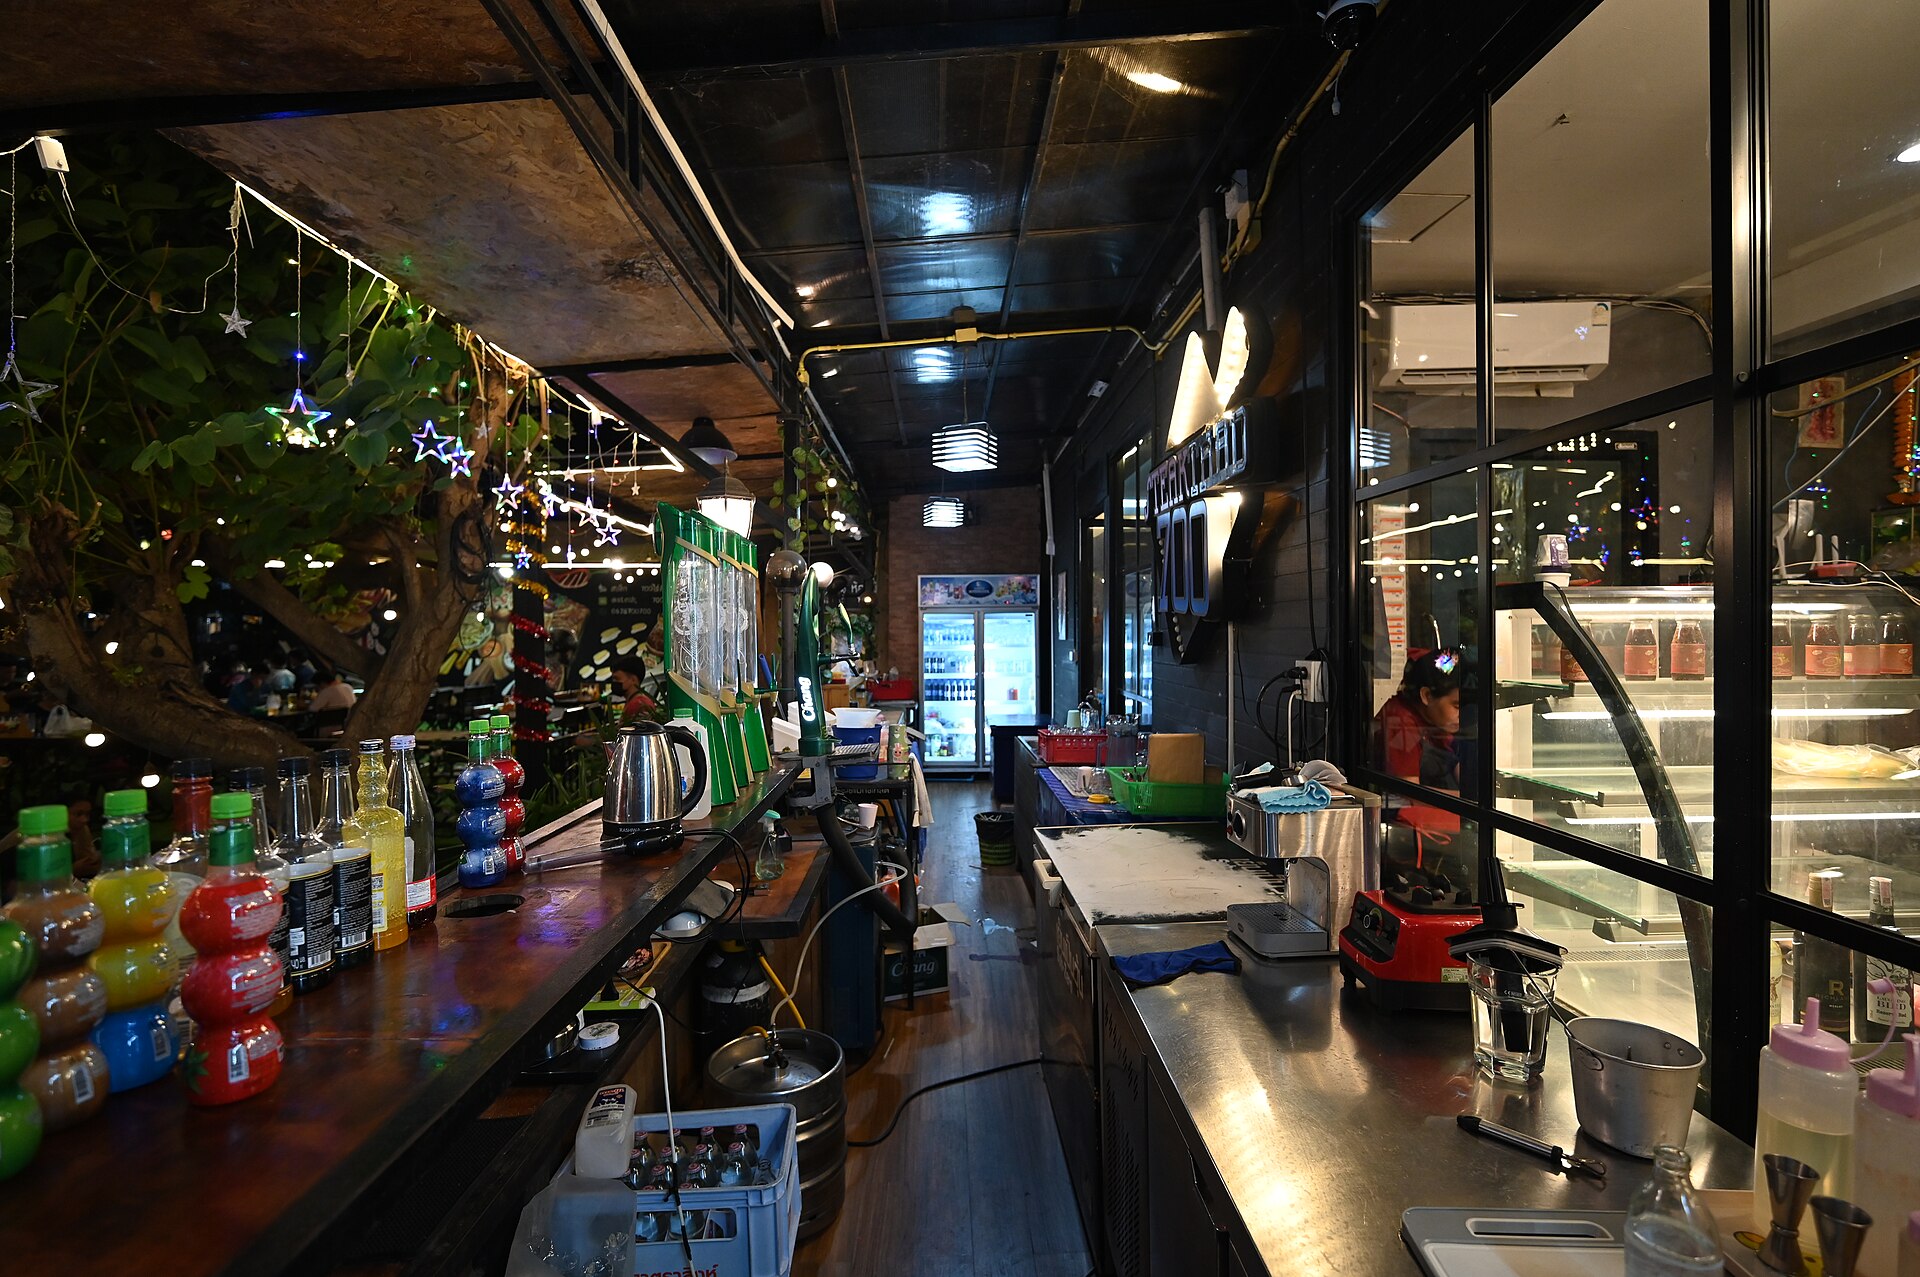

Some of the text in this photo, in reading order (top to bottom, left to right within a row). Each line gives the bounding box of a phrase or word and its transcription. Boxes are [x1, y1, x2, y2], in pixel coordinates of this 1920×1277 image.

[1156, 498, 1210, 617] 700
[797, 675, 816, 722] Chang
[891, 961, 936, 977] Cng
[1829, 980, 1844, 996] R
[1877, 1000, 1907, 1010] BID
